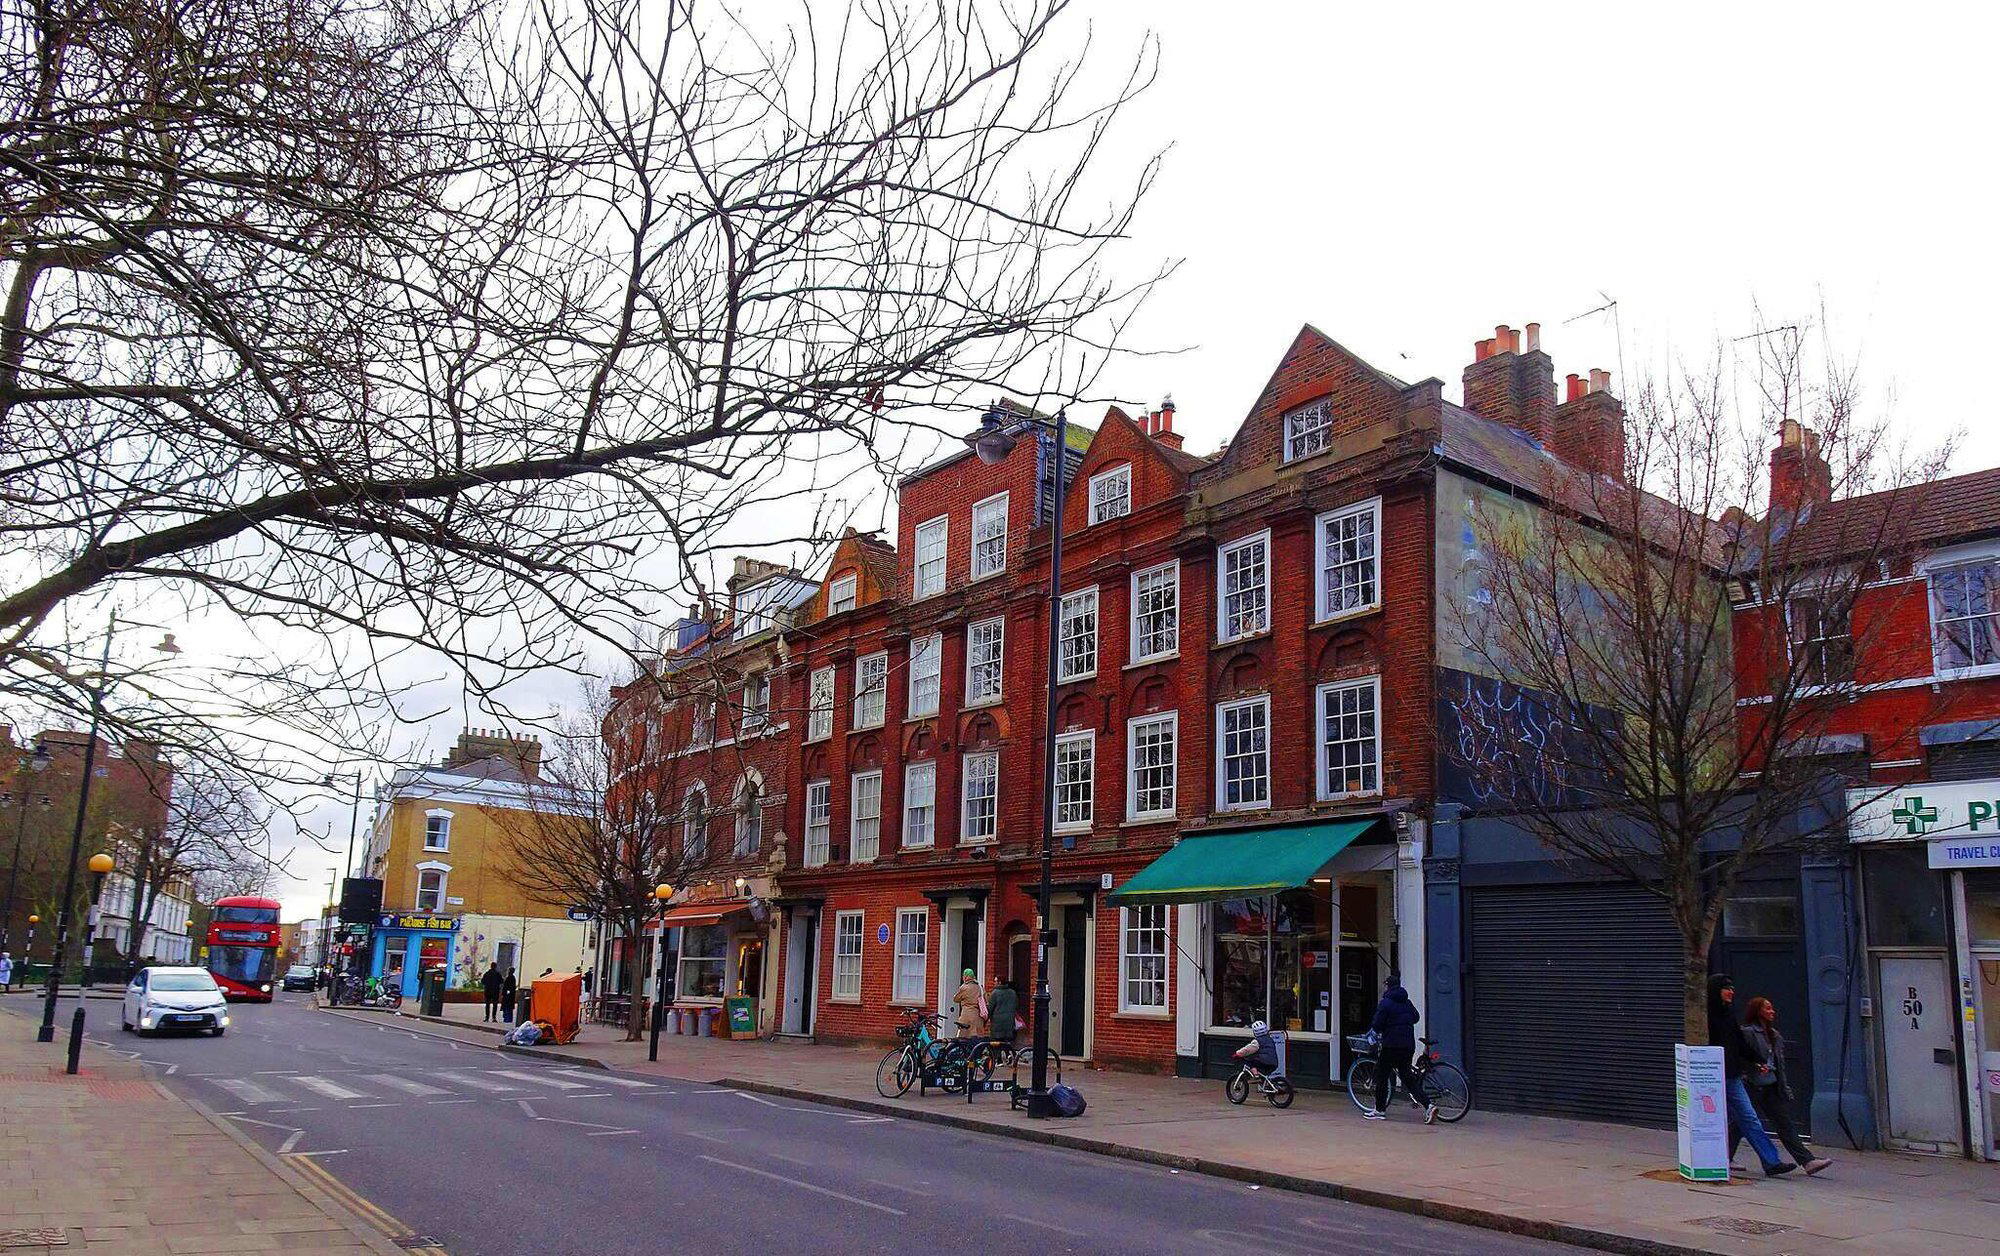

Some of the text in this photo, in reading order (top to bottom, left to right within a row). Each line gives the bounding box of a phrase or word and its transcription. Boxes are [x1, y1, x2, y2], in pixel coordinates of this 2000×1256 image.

[1947, 847, 1987, 859] TRAVEL
[1908, 987, 1917, 999] B
[1903, 1000, 1923, 1016] 50
[1911, 1018, 1919, 1030] A
